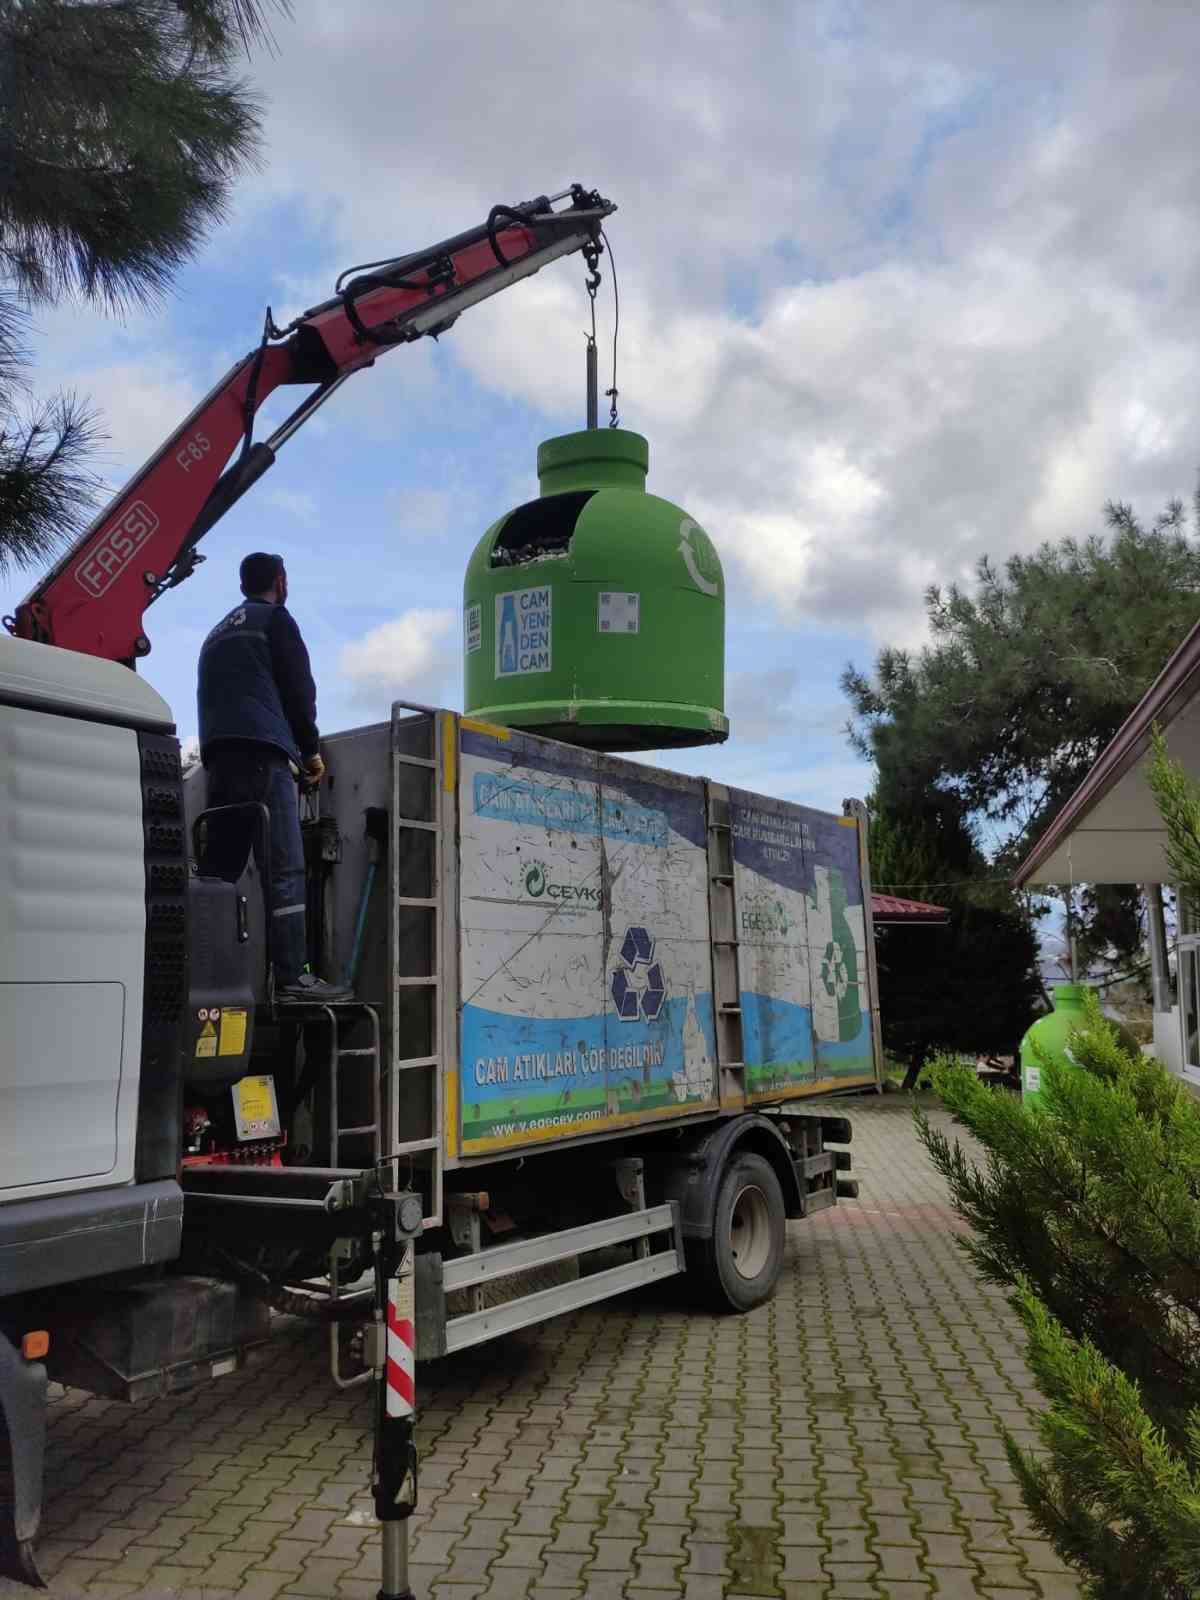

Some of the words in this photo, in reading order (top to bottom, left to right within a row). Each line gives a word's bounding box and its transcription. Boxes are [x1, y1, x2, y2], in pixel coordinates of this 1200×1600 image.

[175, 432, 211, 473] F85
[82, 507, 153, 590] FASSI
[520, 591, 549, 610] CAM
[520, 609, 549, 631] YENİ
[520, 631, 549, 650] DEN
[520, 652, 549, 671] CAM
[475, 1055, 509, 1086] CAM
[513, 1048, 577, 1081] ATIKLARI
